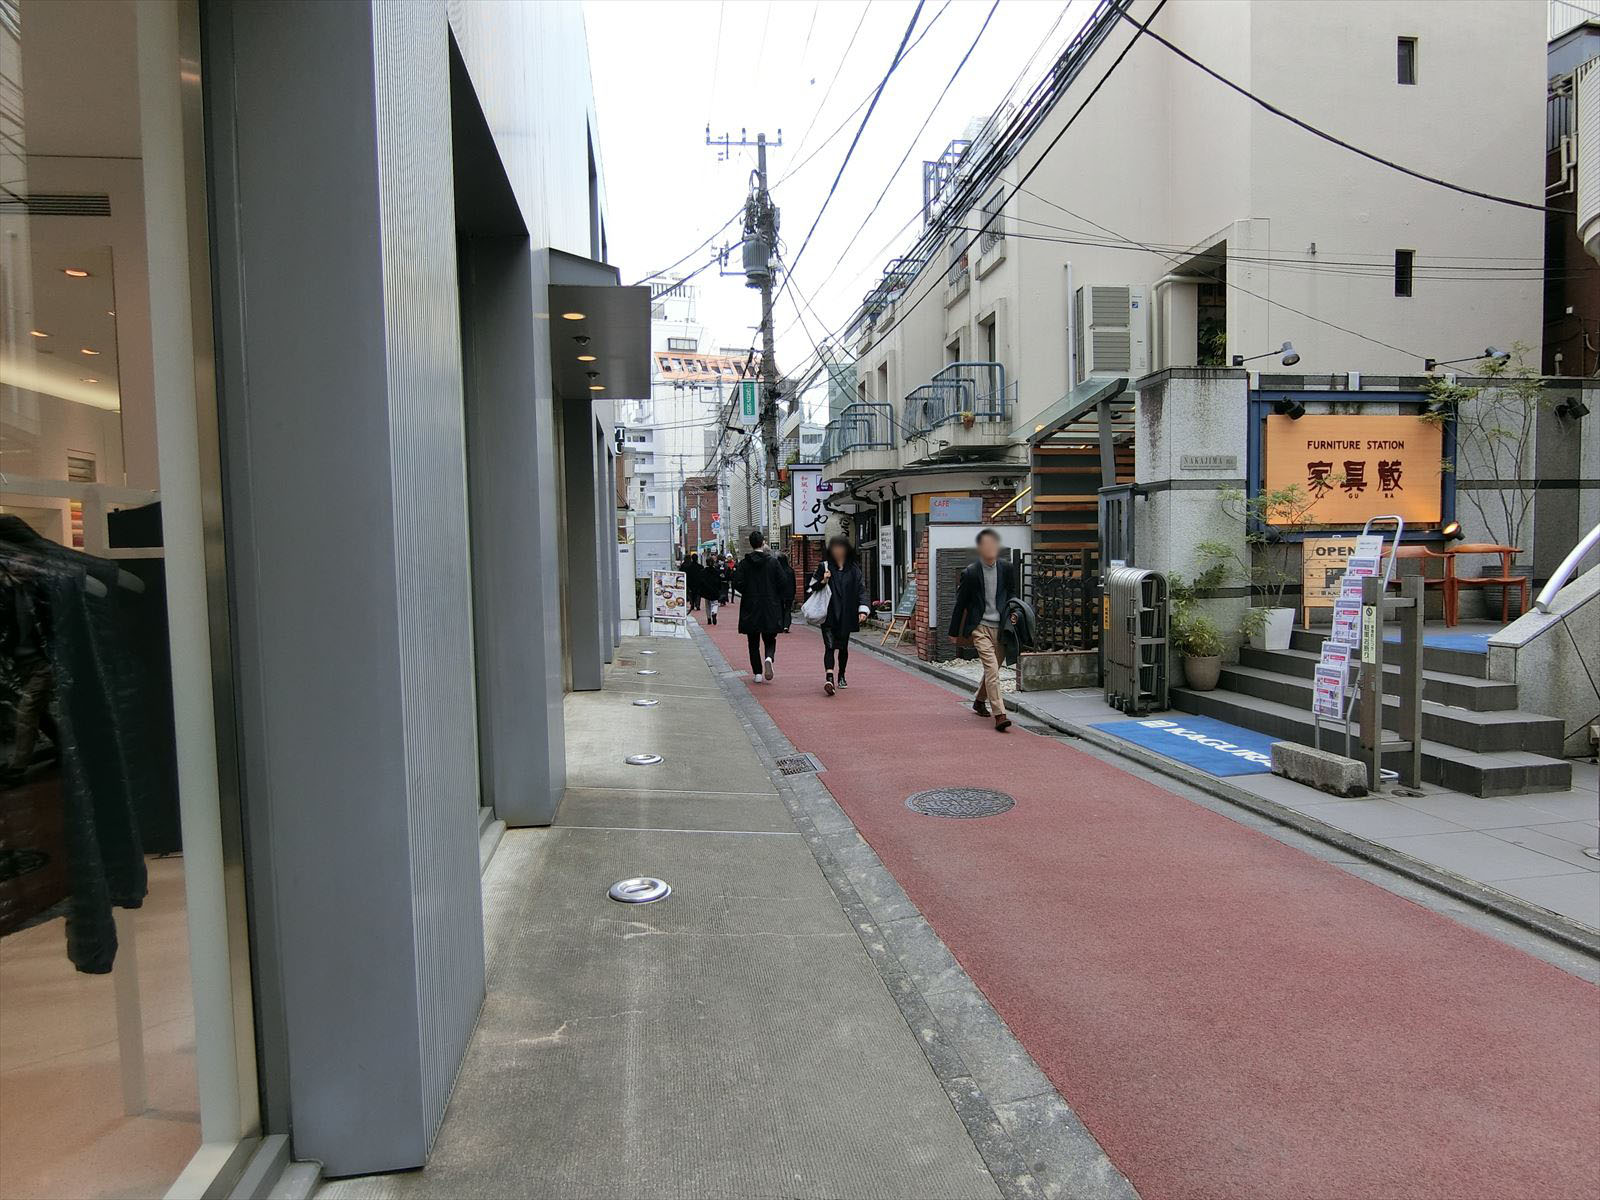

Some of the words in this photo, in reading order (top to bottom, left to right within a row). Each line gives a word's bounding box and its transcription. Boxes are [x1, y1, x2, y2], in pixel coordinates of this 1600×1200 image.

[1307, 441, 1361, 450] FURNITURE
[1367, 441, 1405, 450] STATION
[1183, 456, 1223, 465] NAKAJIMA
[1316, 546, 1356, 556] OPEN
